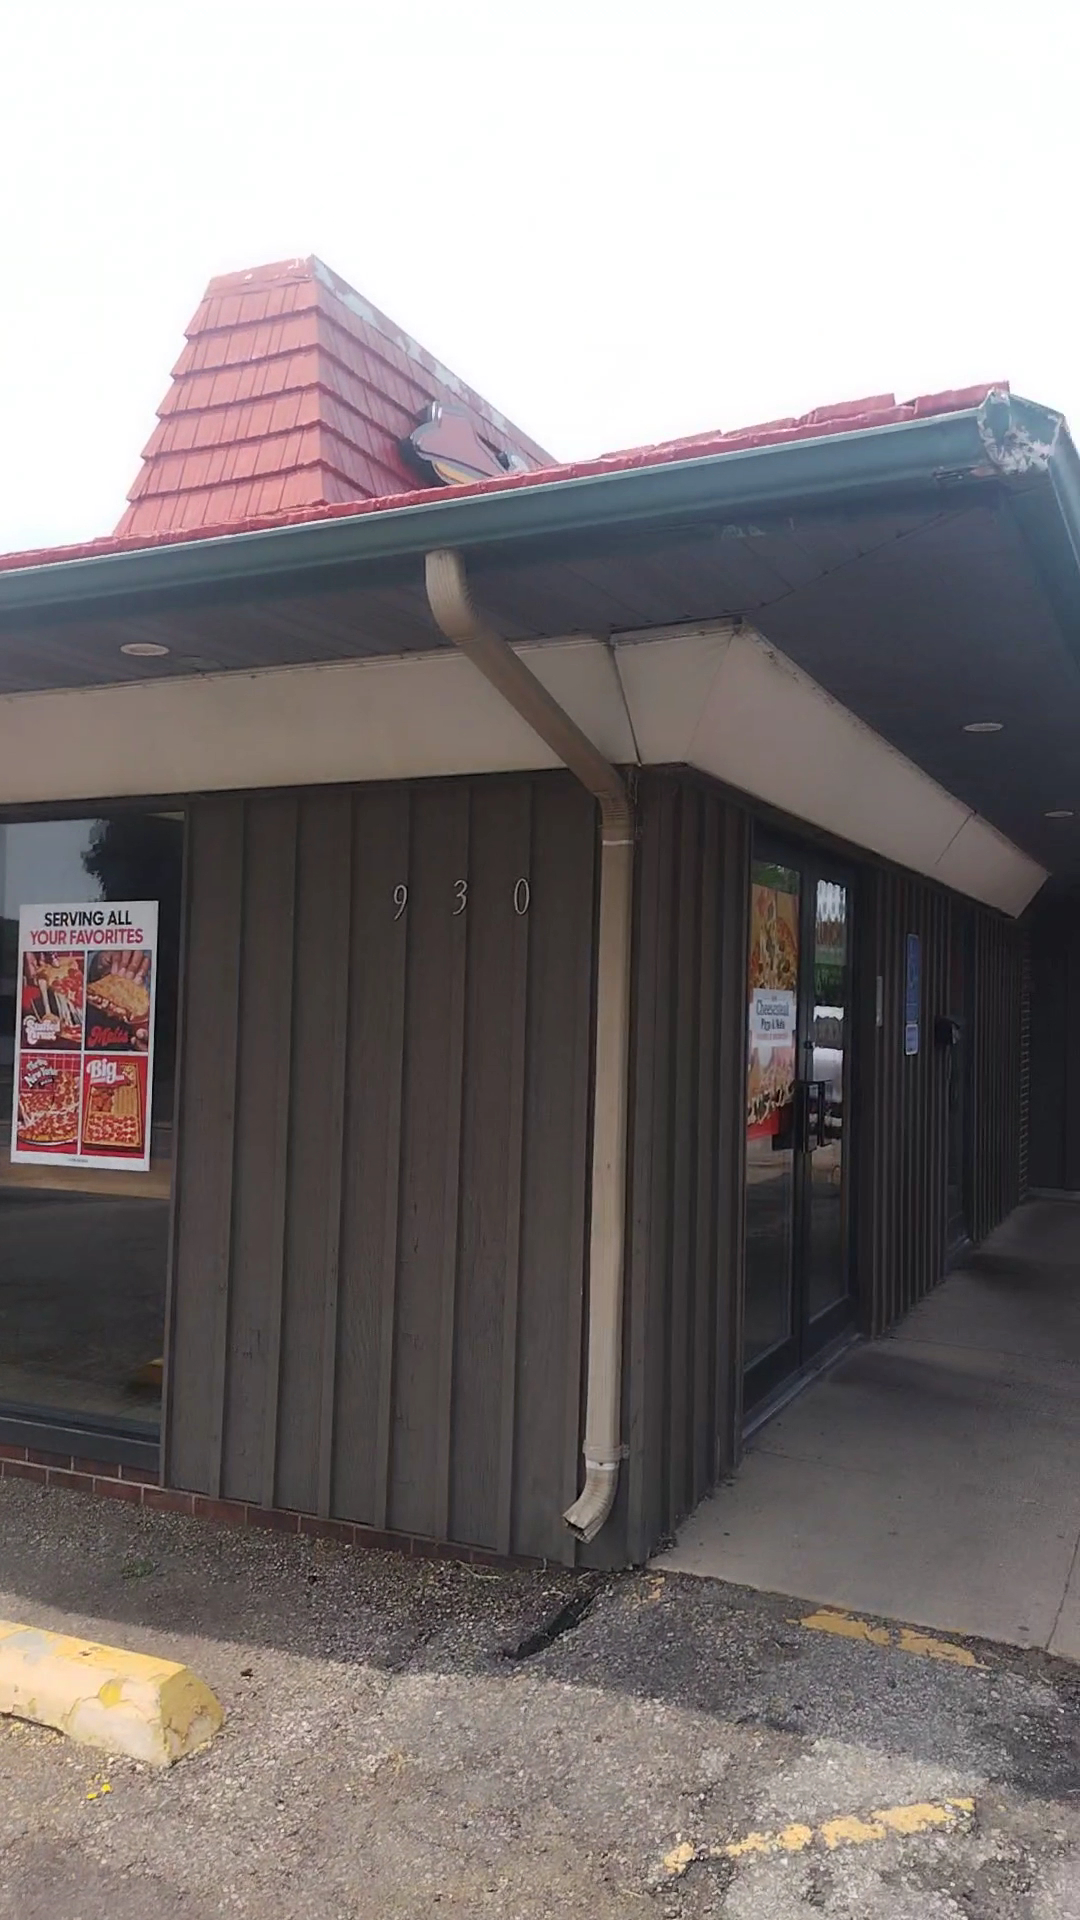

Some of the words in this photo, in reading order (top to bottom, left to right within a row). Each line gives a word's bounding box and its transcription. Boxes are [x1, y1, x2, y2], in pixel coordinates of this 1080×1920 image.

[393, 877, 530, 921] 930
[44, 911, 104, 927] SERVING
[107, 910, 132, 926] ALL
[30, 930, 67, 945] YOUR
[70, 928, 144, 945] FAVORITES
[87, 1058, 117, 1084] Big
